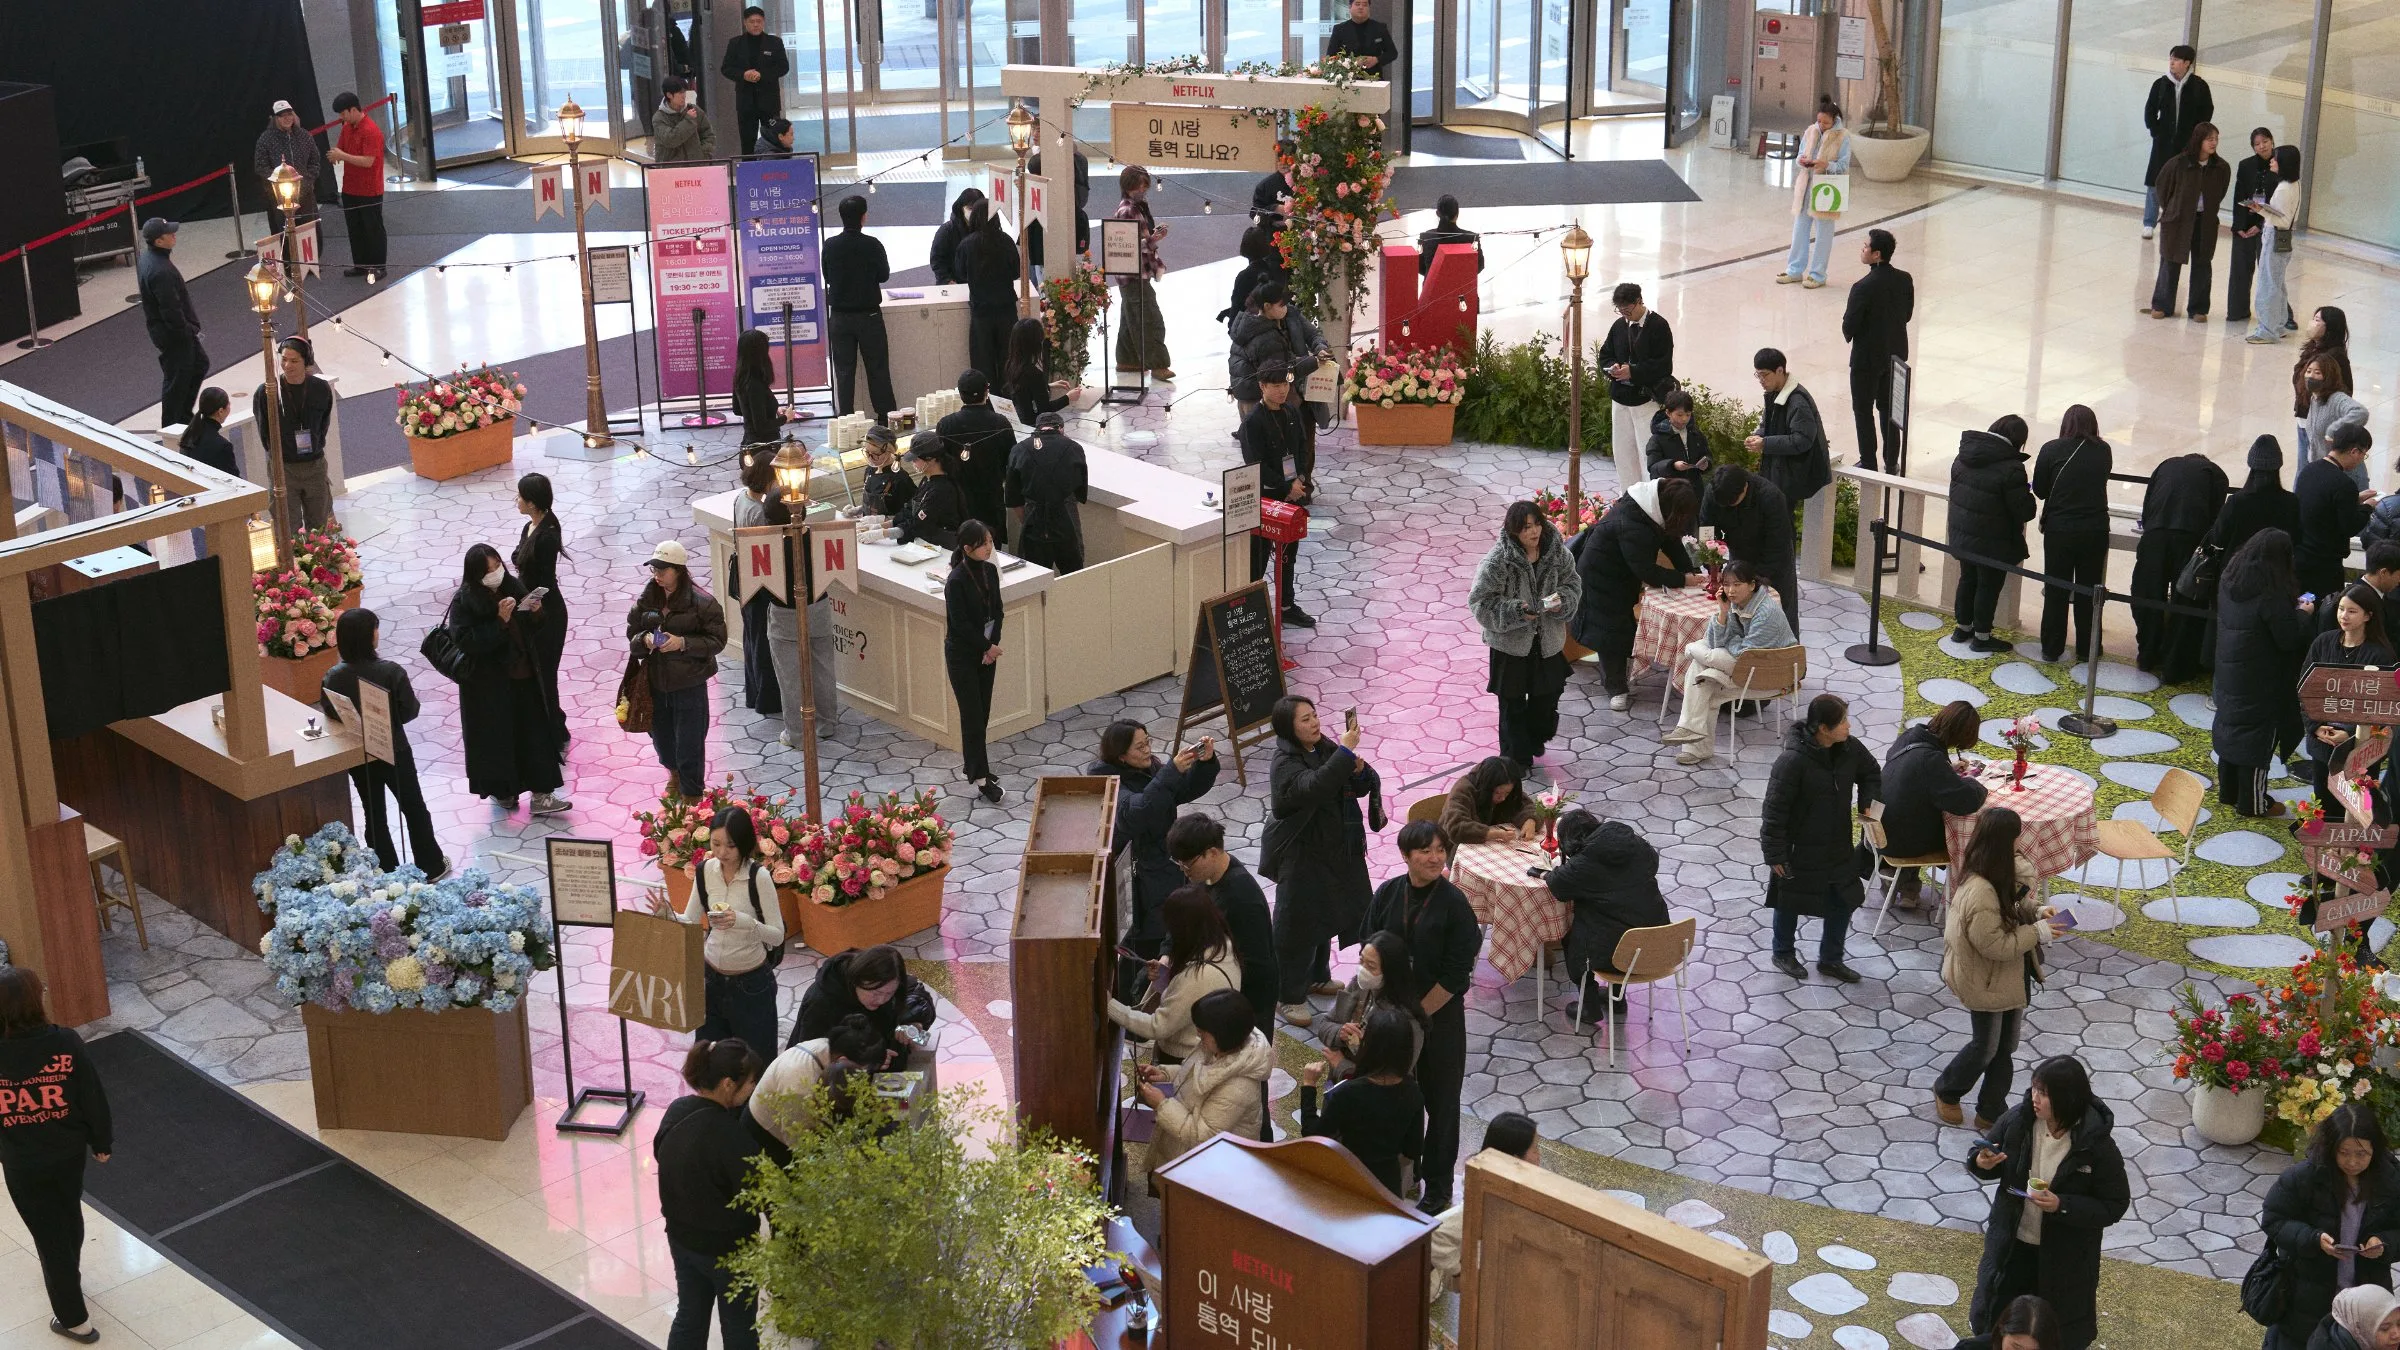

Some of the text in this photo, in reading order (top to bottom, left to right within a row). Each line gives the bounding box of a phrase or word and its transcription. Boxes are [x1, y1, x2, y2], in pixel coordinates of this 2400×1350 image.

[1173, 85, 1215, 98] NETFLIX
[1149, 118, 1201, 138] 이 사랑
[1148, 138, 1240, 160] 통역 되나요?
[541, 177, 556, 202] N
[588, 171, 602, 195] N
[674, 180, 702, 188] NETFLIX
[749, 185, 781, 198] 이 사랑
[994, 178, 1005, 203] N
[750, 198, 807, 211] 통역 되나요?
[1031, 187, 1041, 212] N
[661, 228, 690, 236] TICKET
[748, 226, 811, 238] TOUR GUIDE
[302, 236, 313, 263] N
[1260, 523, 1282, 535] POST
[751, 543, 772, 577] N
[824, 538, 845, 572] N
[2326, 677, 2382, 695] 이 사랑
[2323, 695, 2355, 714] 통역
[2326, 828, 2384, 844] JAPAN
[2321, 853, 2360, 883] ITALY
[2326, 896, 2378, 922] CANADA
[608, 966, 687, 1028] ZARA
[3, 1108, 70, 1128] AVENTURE
[1231, 1249, 1294, 1294] NETFLIX
[1198, 1269, 1274, 1324] 이 사랑
[1197, 1300, 1240, 1346] 통역
